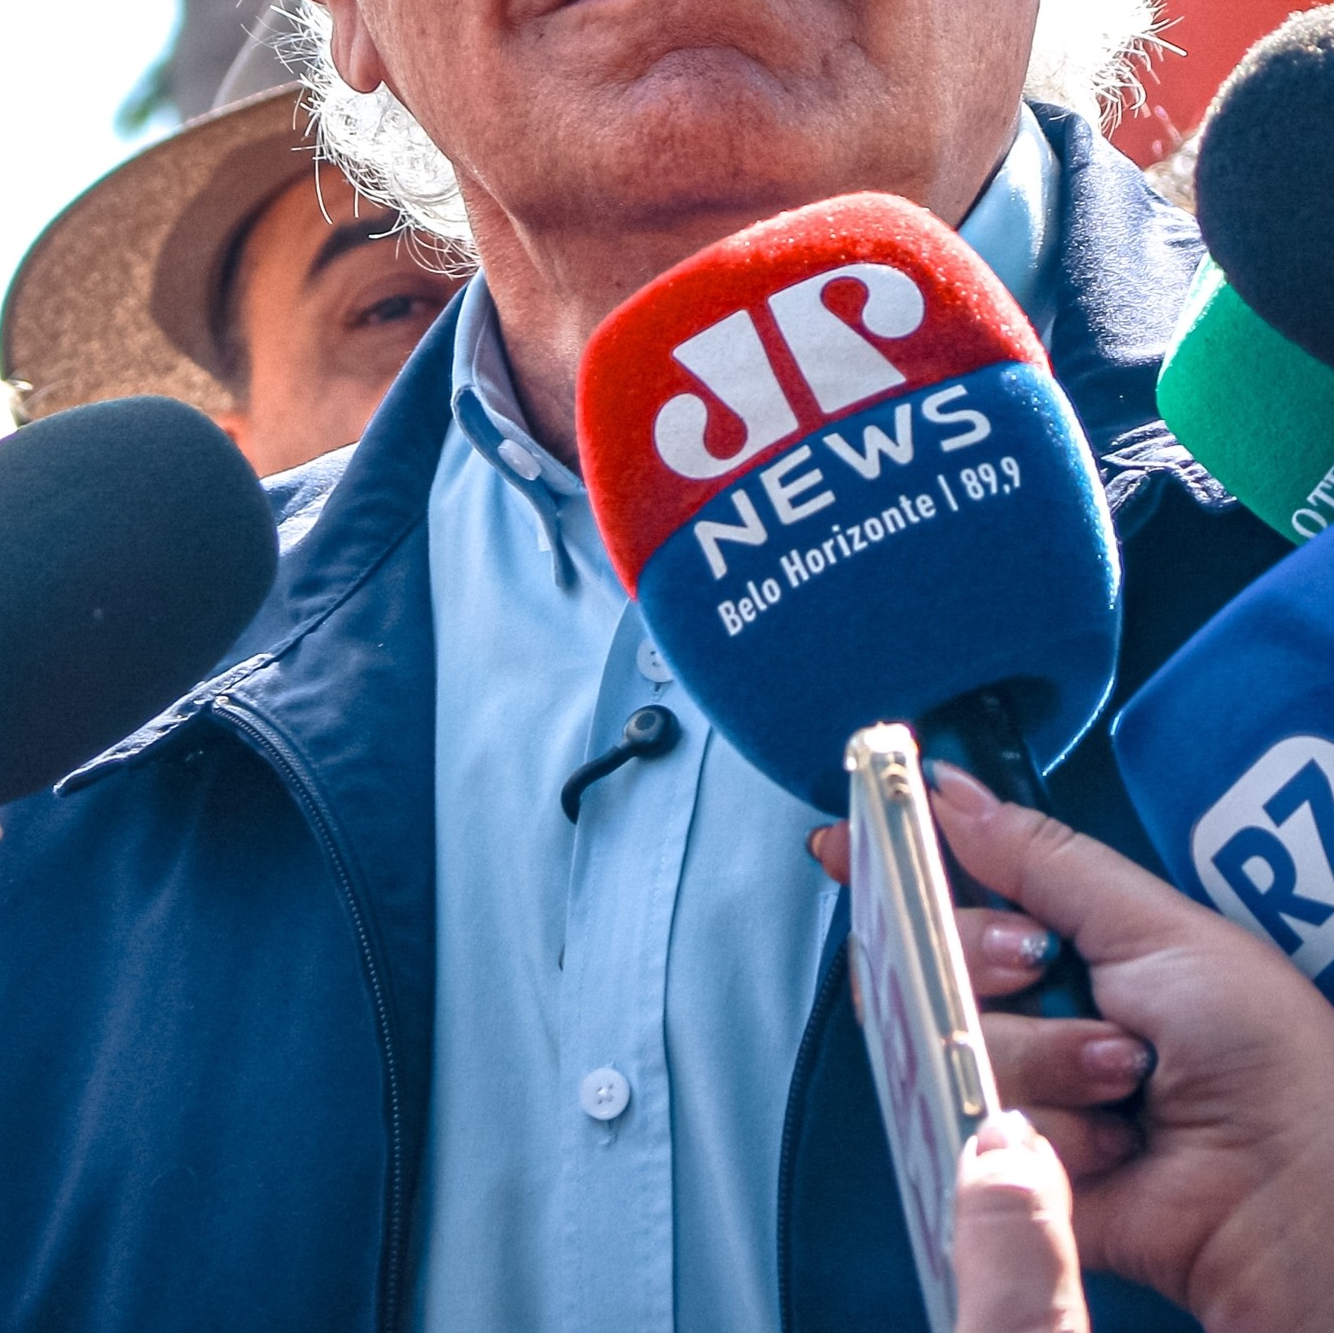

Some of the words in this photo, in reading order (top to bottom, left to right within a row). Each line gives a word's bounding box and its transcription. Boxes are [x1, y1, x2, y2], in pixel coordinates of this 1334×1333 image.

[654, 263, 925, 479] JP
[694, 384, 991, 580] NEWS
[717, 578, 781, 637] Belo
[780, 494, 937, 588] Horizonte
[961, 456, 1022, 501] 89,9
